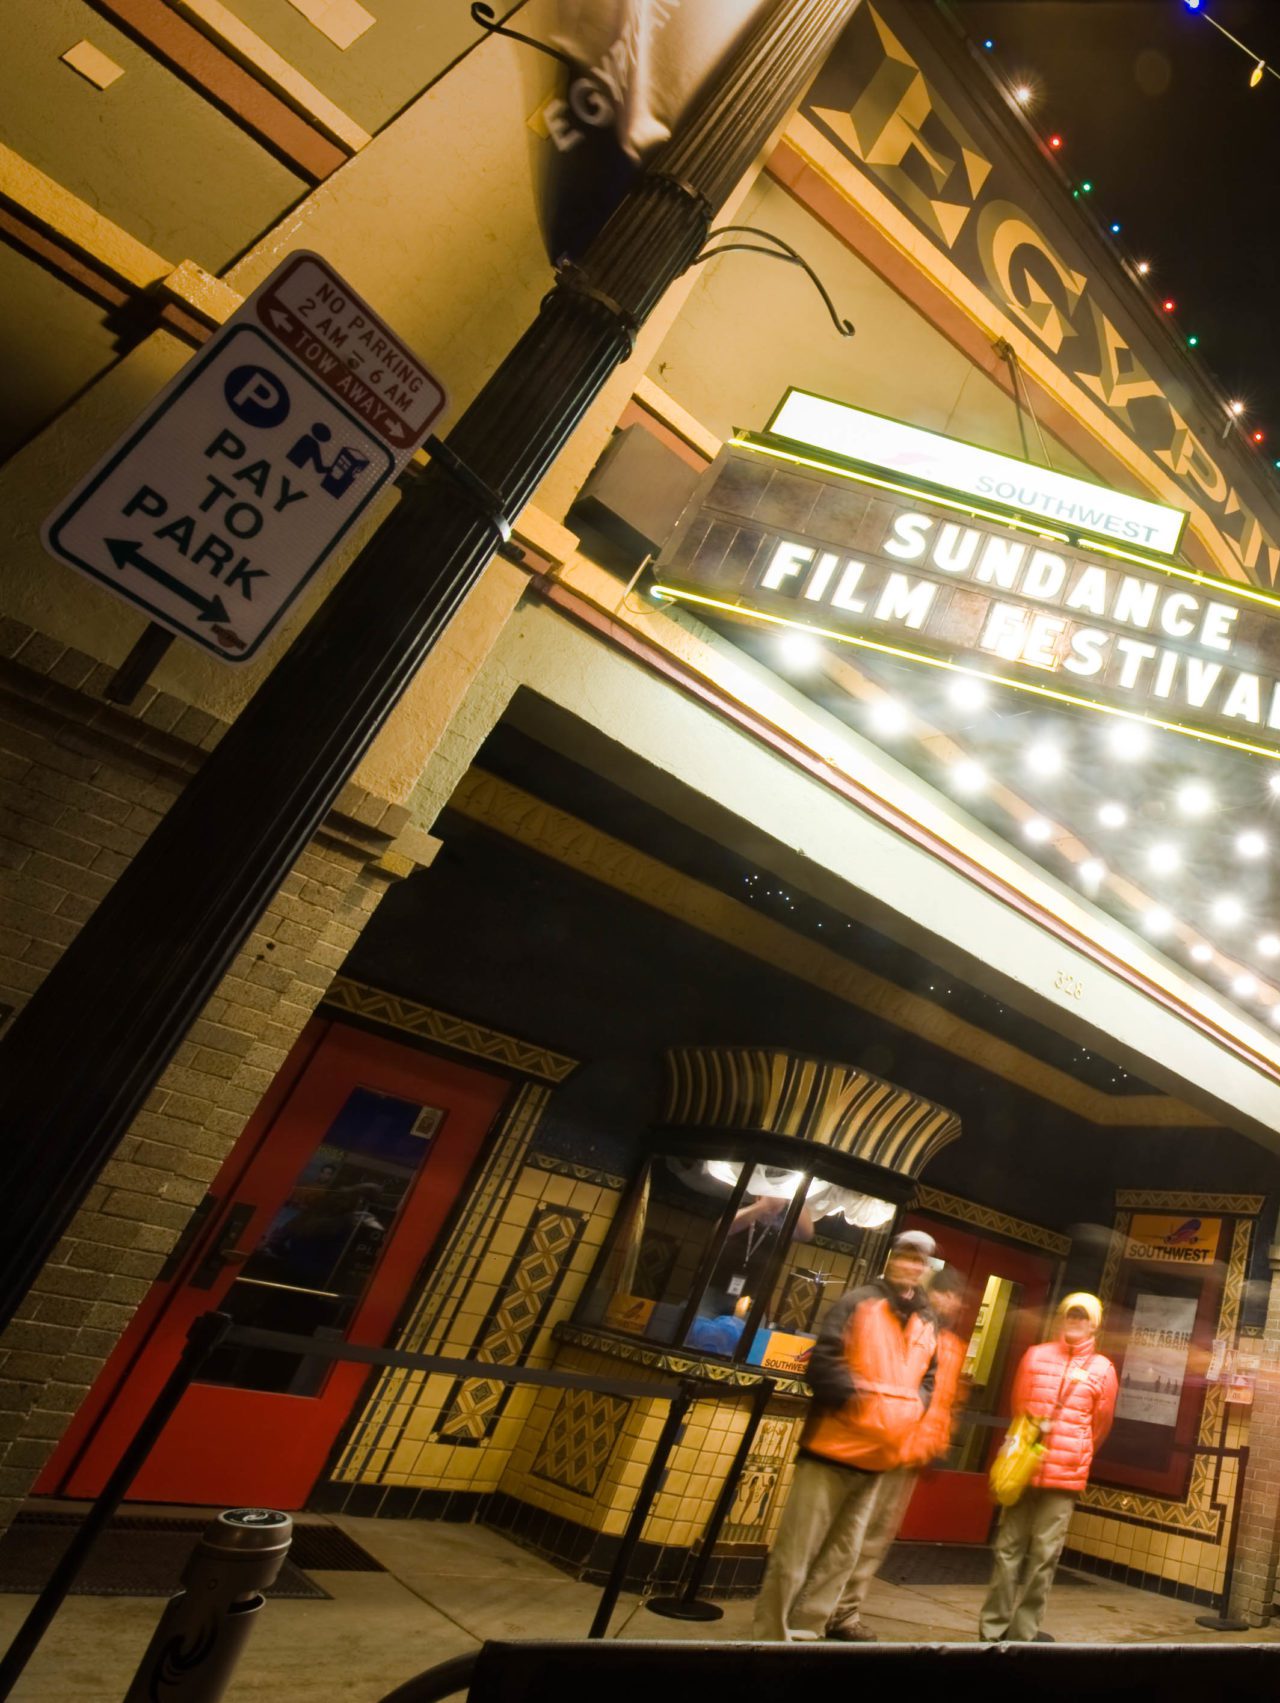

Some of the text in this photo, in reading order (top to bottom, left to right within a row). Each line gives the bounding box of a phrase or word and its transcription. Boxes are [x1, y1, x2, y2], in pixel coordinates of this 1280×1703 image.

[294, 331, 385, 420] TOW AWAY
[298, 298, 316, 319] 2
[316, 318, 349, 348] AM
[369, 369, 385, 384] 6
[384, 384, 413, 412] AM
[316, 283, 424, 393] NO PARKING
[232, 372, 280, 409] P
[198, 474, 263, 540] TO
[204, 428, 309, 513] PAY
[975, 475, 1159, 543] SOUTHWEST
[121, 484, 271, 601] PARK
[760, 540, 940, 630] FILM
[882, 512, 1238, 651] SUNDANCE
[1128, 1244, 1210, 1263] SOUTHWEST
[765, 1358, 808, 1372] SOUTHWES
